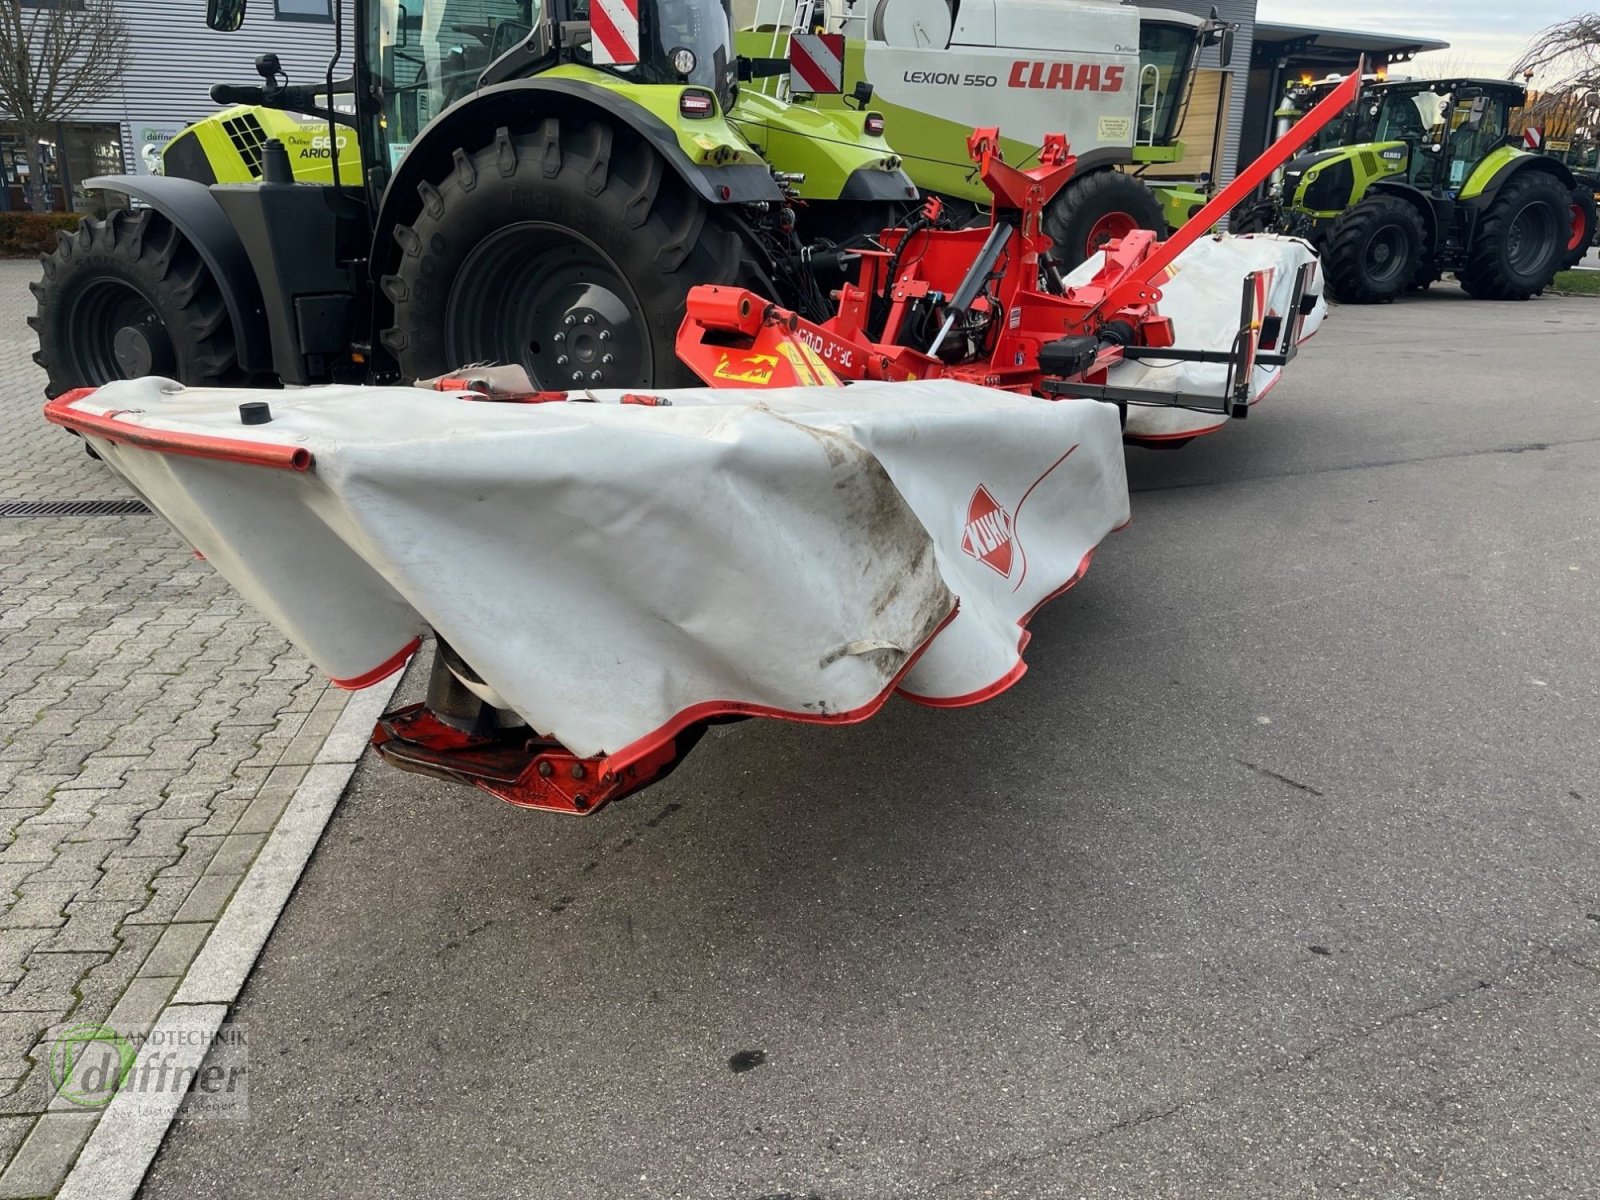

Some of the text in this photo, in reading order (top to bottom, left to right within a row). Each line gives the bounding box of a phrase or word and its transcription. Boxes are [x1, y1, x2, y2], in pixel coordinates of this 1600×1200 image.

[903, 71, 998, 88] LEXION 550
[1007, 60, 1125, 92] CLAAS
[964, 505, 1013, 562] KUHN
